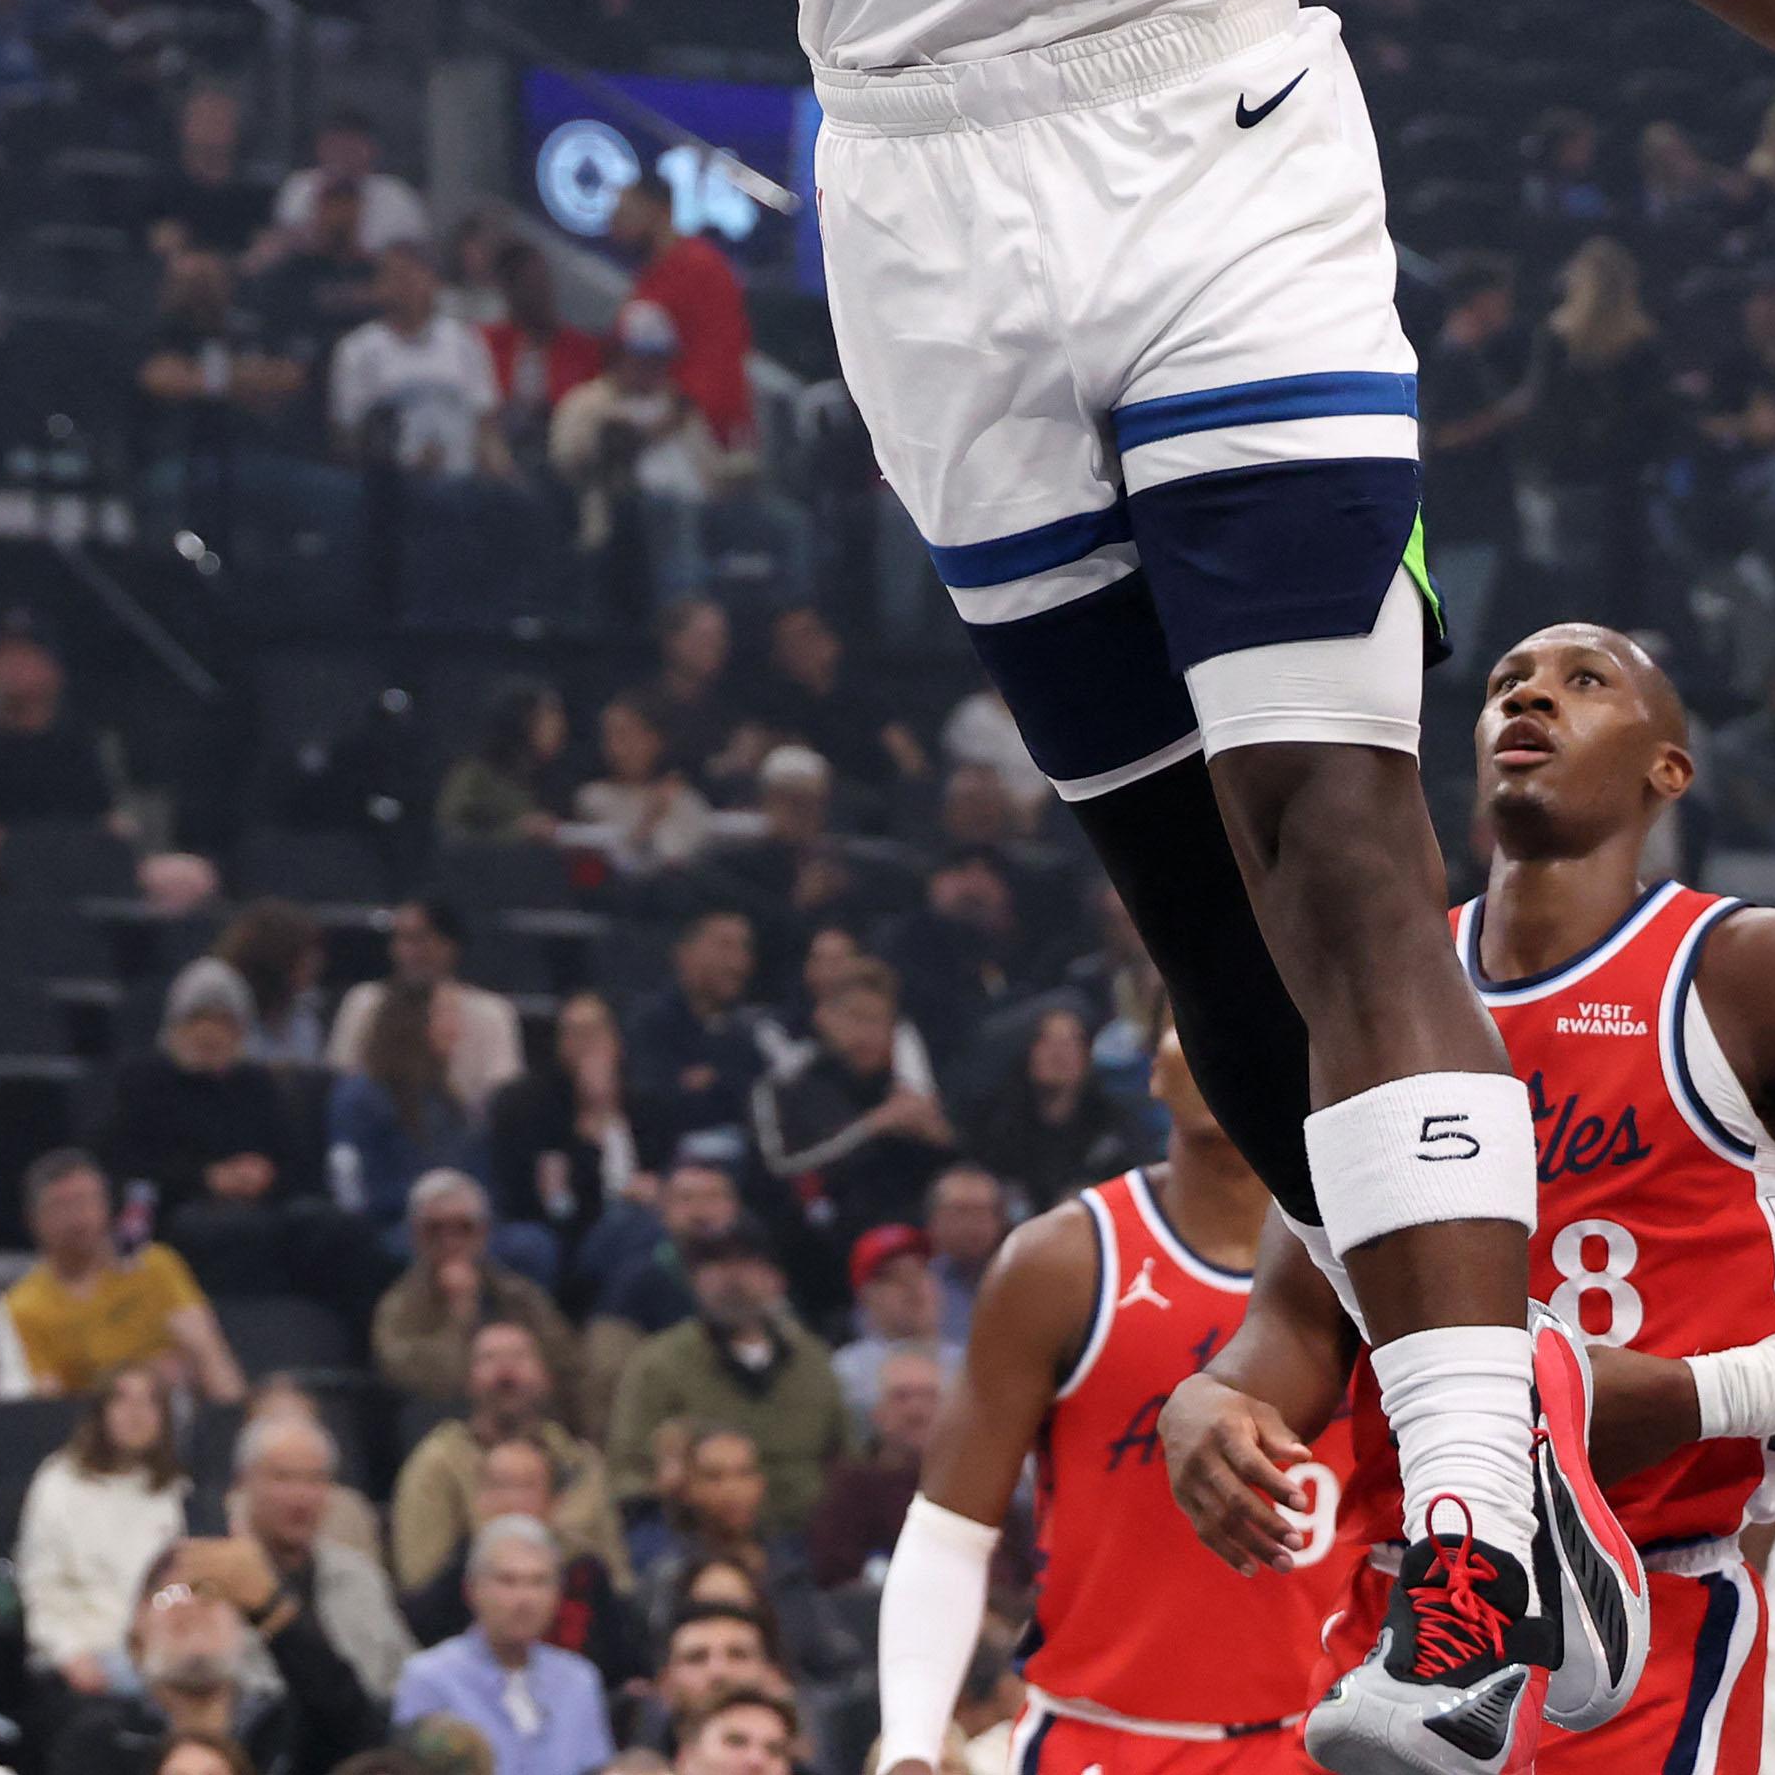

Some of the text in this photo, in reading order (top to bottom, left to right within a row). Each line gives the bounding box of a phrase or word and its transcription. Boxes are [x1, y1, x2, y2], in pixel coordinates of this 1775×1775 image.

[1578, 1002, 1633, 1021] VISIT
[1556, 1017, 1647, 1036] RWANDA
[1415, 1113, 1481, 1162] 5
